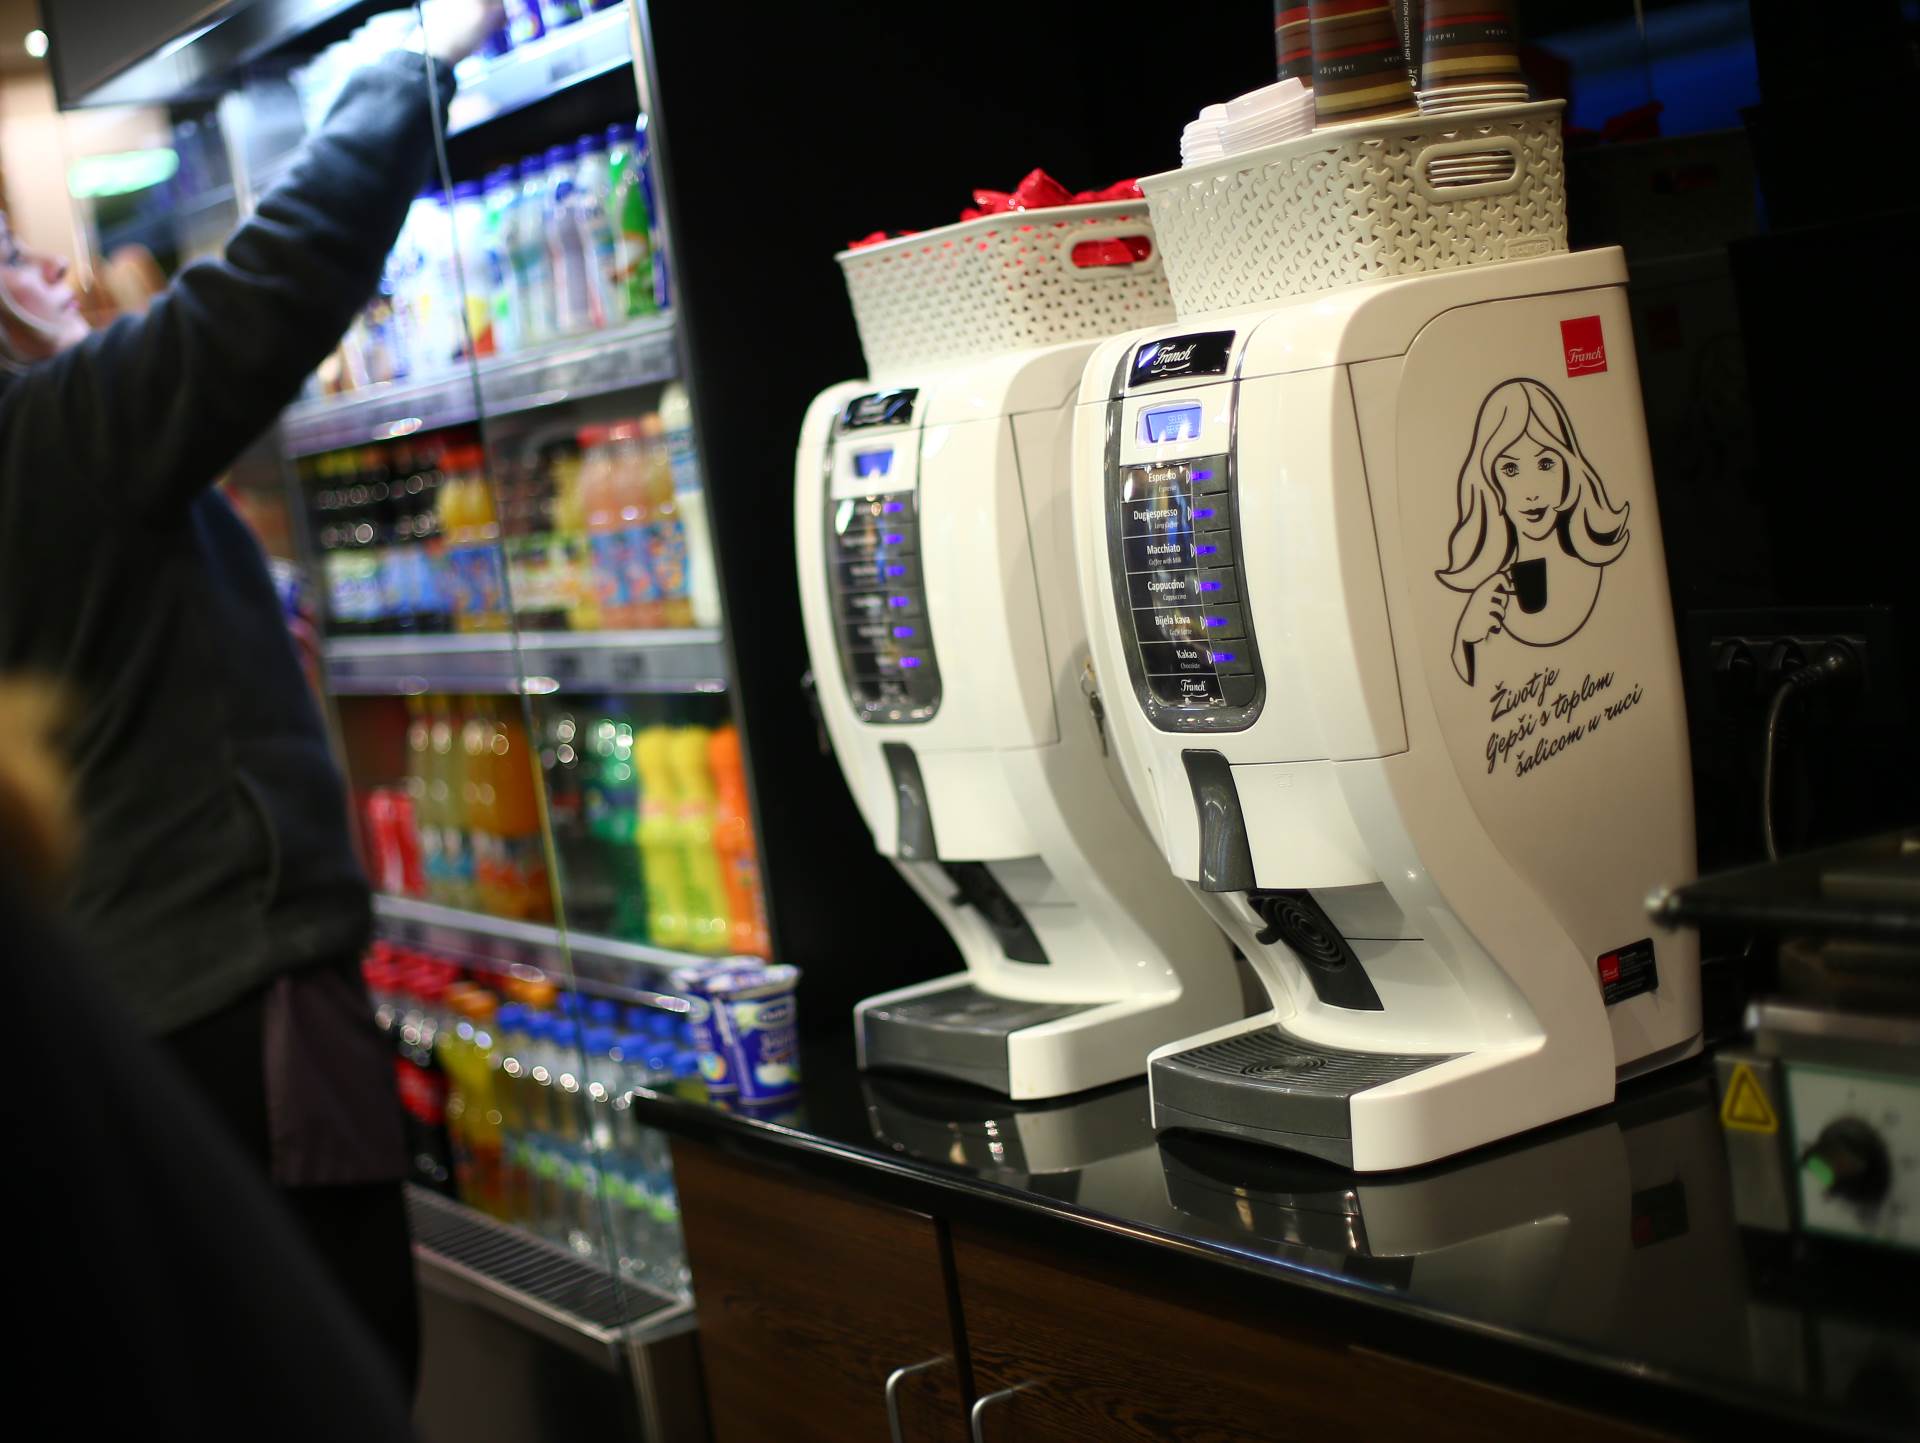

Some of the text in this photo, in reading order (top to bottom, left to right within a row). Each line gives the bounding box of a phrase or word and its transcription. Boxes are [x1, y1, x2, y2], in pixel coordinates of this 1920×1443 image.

[1152, 344, 1197, 367] Franck
[1568, 346, 1604, 365] Franck
[1148, 472, 1177, 483] Espresso
[1146, 543, 1181, 555] Macchiato
[1147, 579, 1185, 593] Cappuccino
[1154, 614, 1191, 628] Bijela kava
[1176, 649, 1198, 659] Kakao
[1180, 679, 1207, 692] Franck
[1490, 666, 1560, 722] Život je
[1539, 710, 1552, 727] s
[1551, 672, 1614, 723] toplom
[1515, 683, 1643, 777] šalicom u ruci
